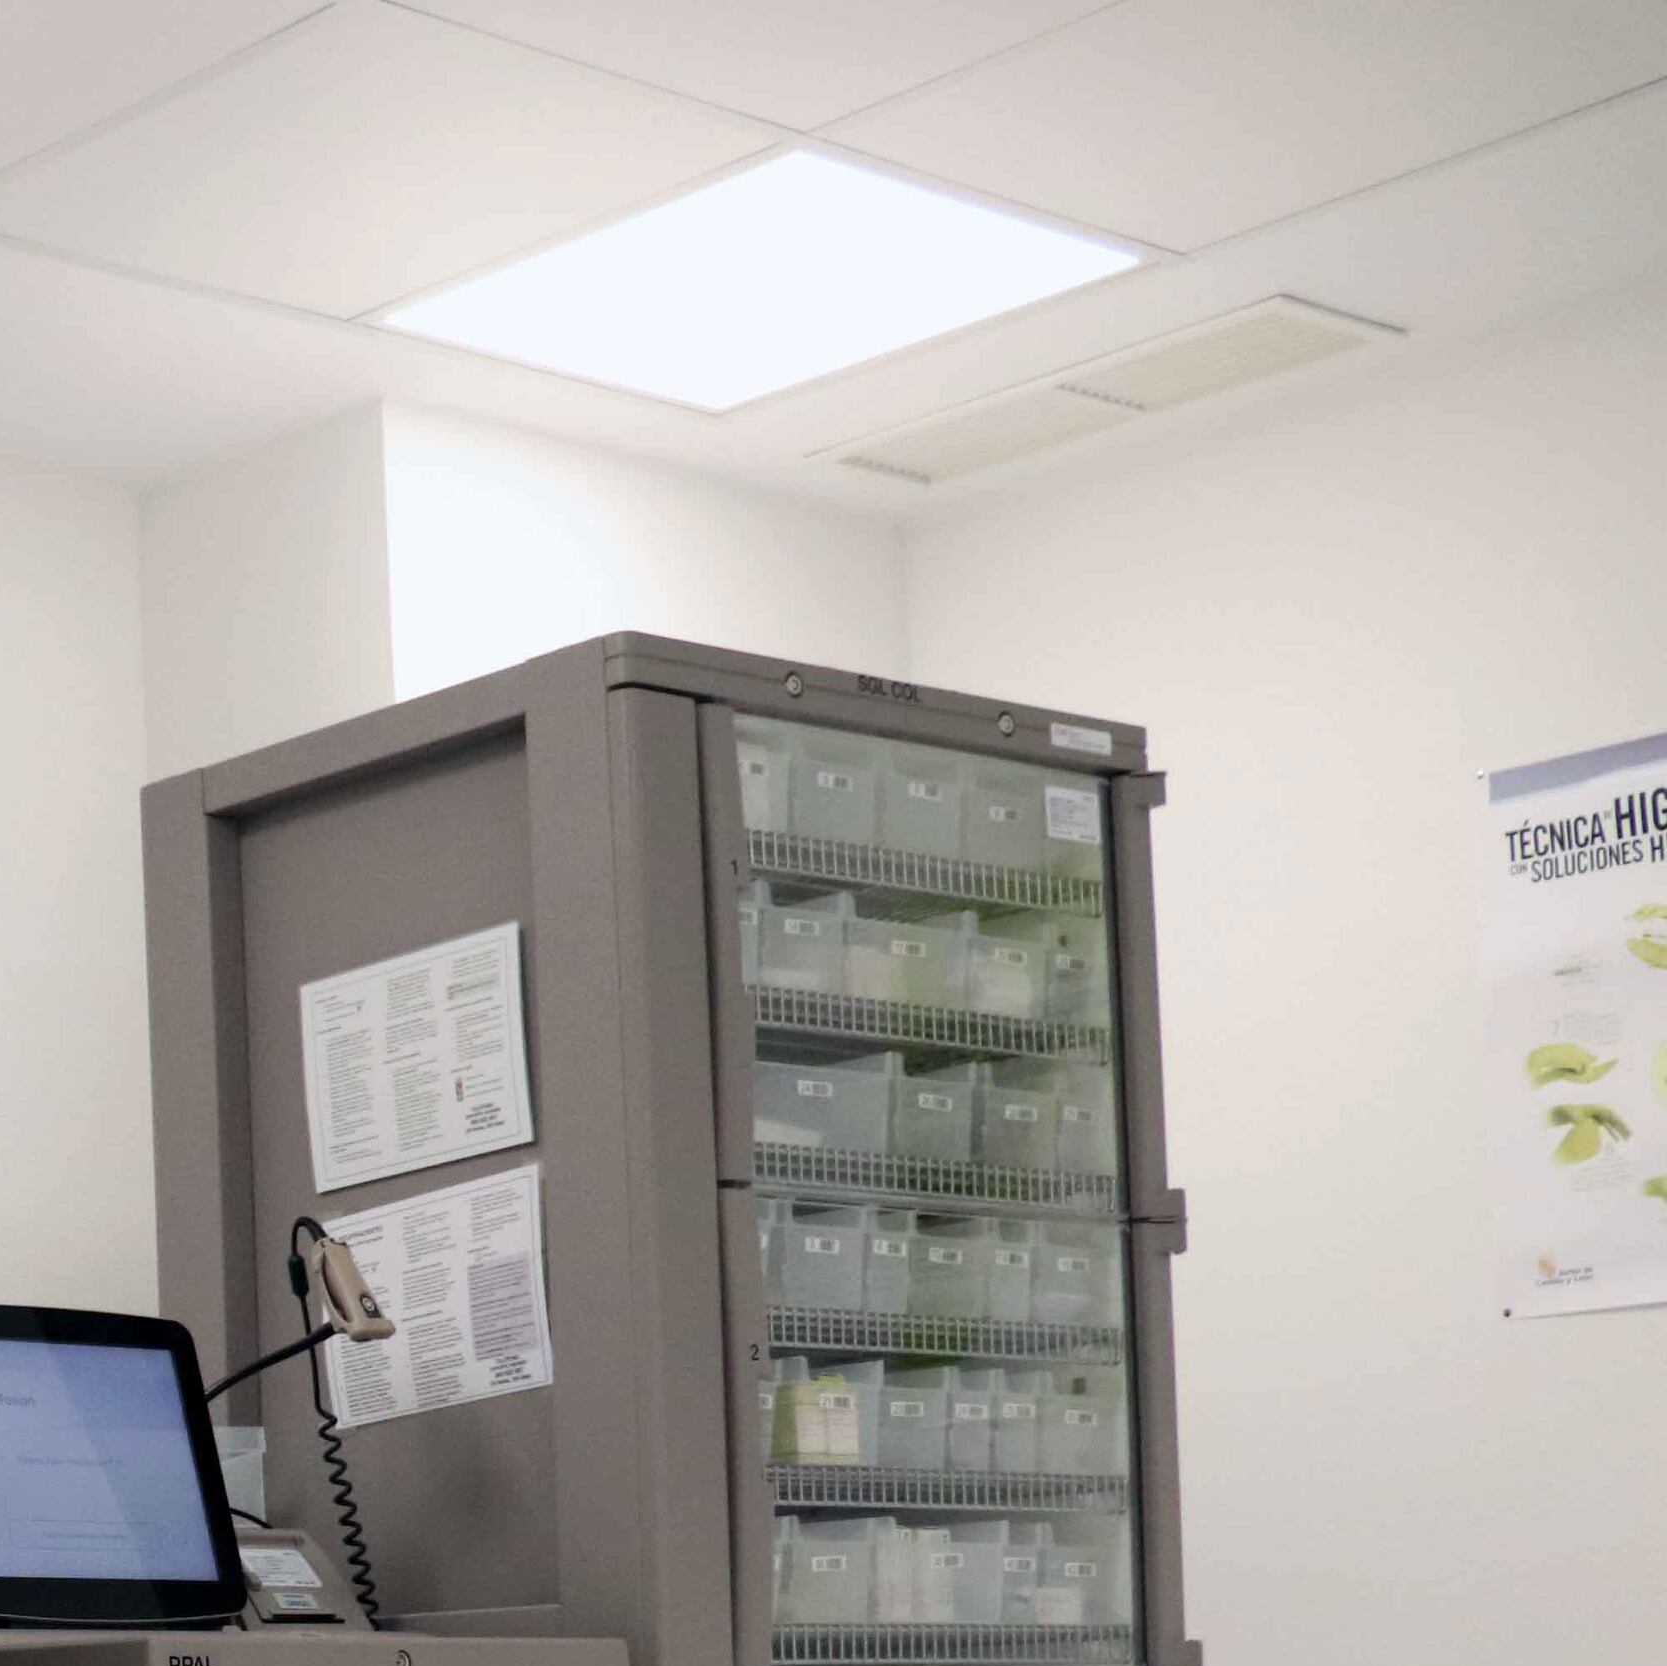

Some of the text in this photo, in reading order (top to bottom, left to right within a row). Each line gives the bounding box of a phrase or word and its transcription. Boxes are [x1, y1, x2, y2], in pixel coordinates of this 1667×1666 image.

[1505, 812, 1606, 862] TÉCNICA
[730, 860, 739, 875] 1
[1531, 839, 1644, 883] SOLUCIONES
[751, 1344, 760, 1361] 2
